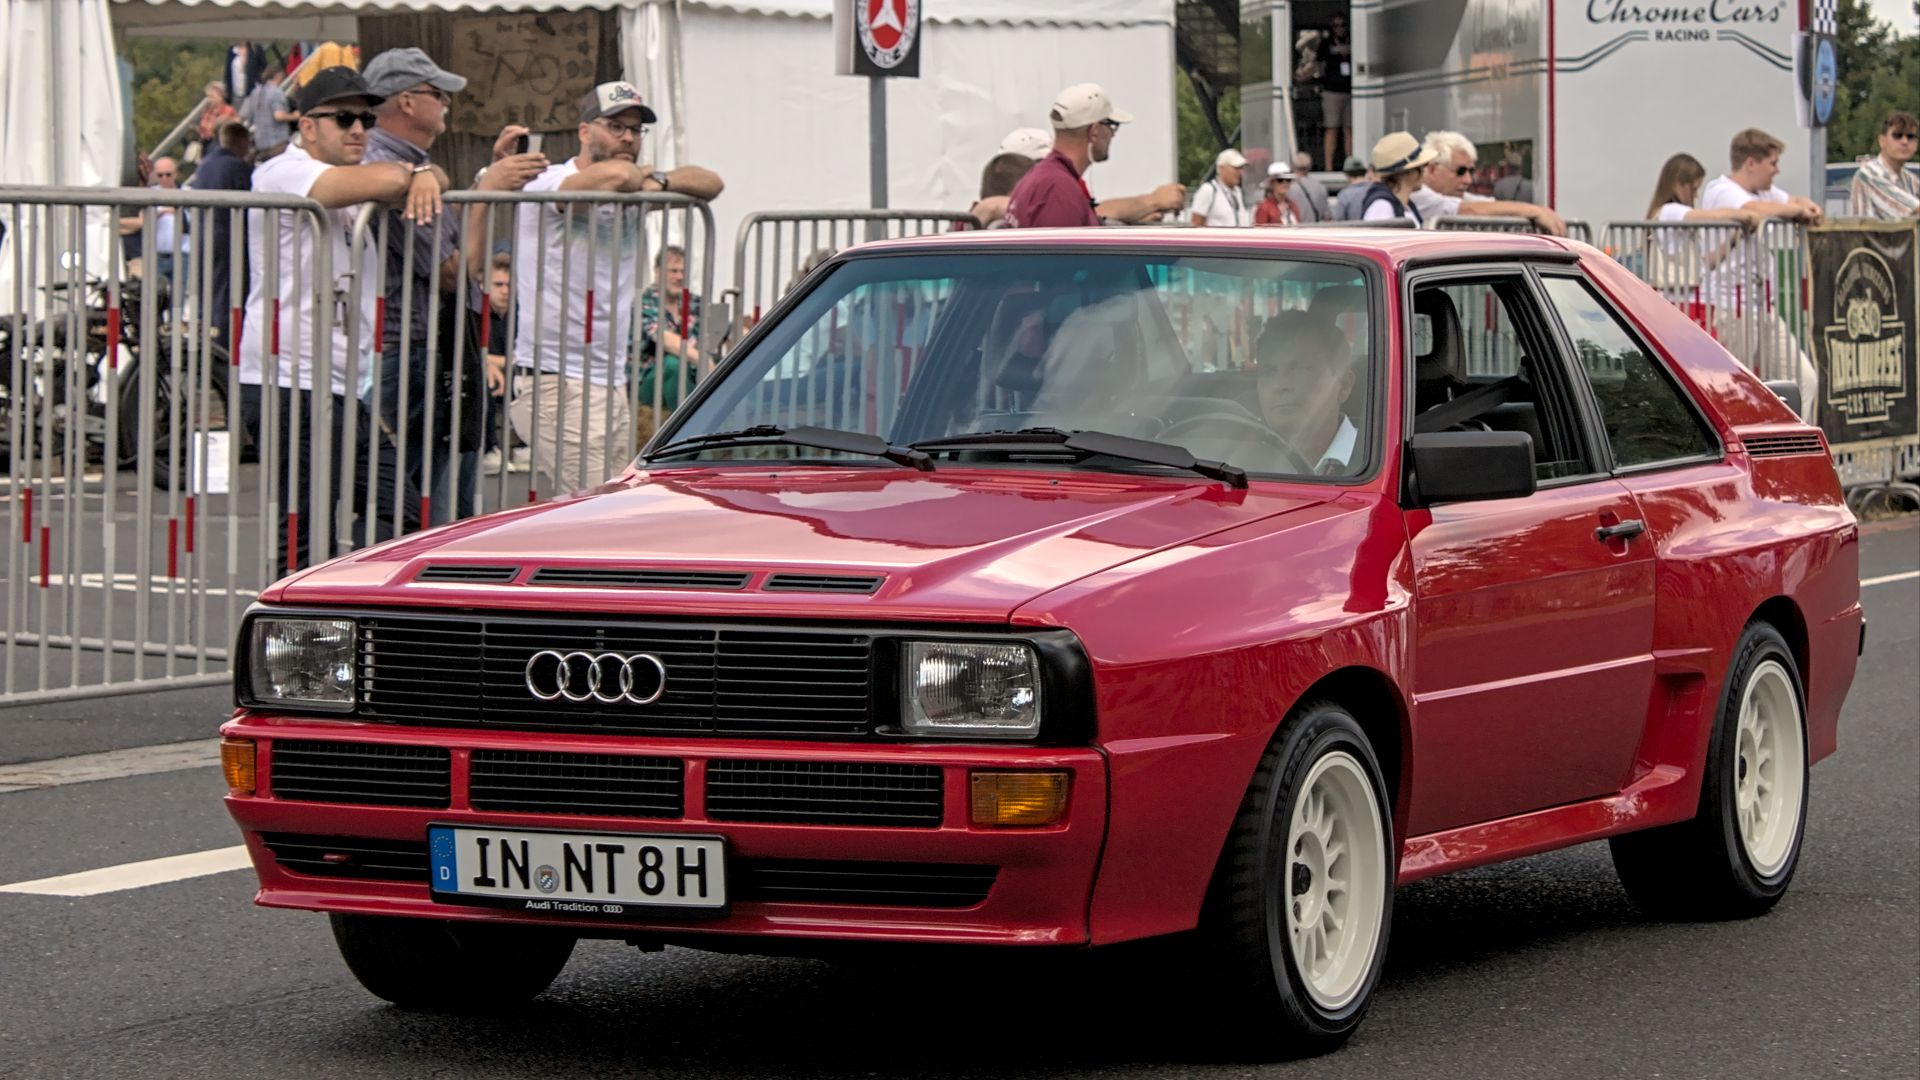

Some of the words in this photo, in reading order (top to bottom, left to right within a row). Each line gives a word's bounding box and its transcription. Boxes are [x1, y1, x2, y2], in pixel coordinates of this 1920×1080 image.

[1655, 29, 1711, 42] RACING
[473, 837, 530, 890] IN
[440, 866, 450, 881] D
[525, 900, 551, 910] Audi
[552, 902, 599, 913] Tradition
